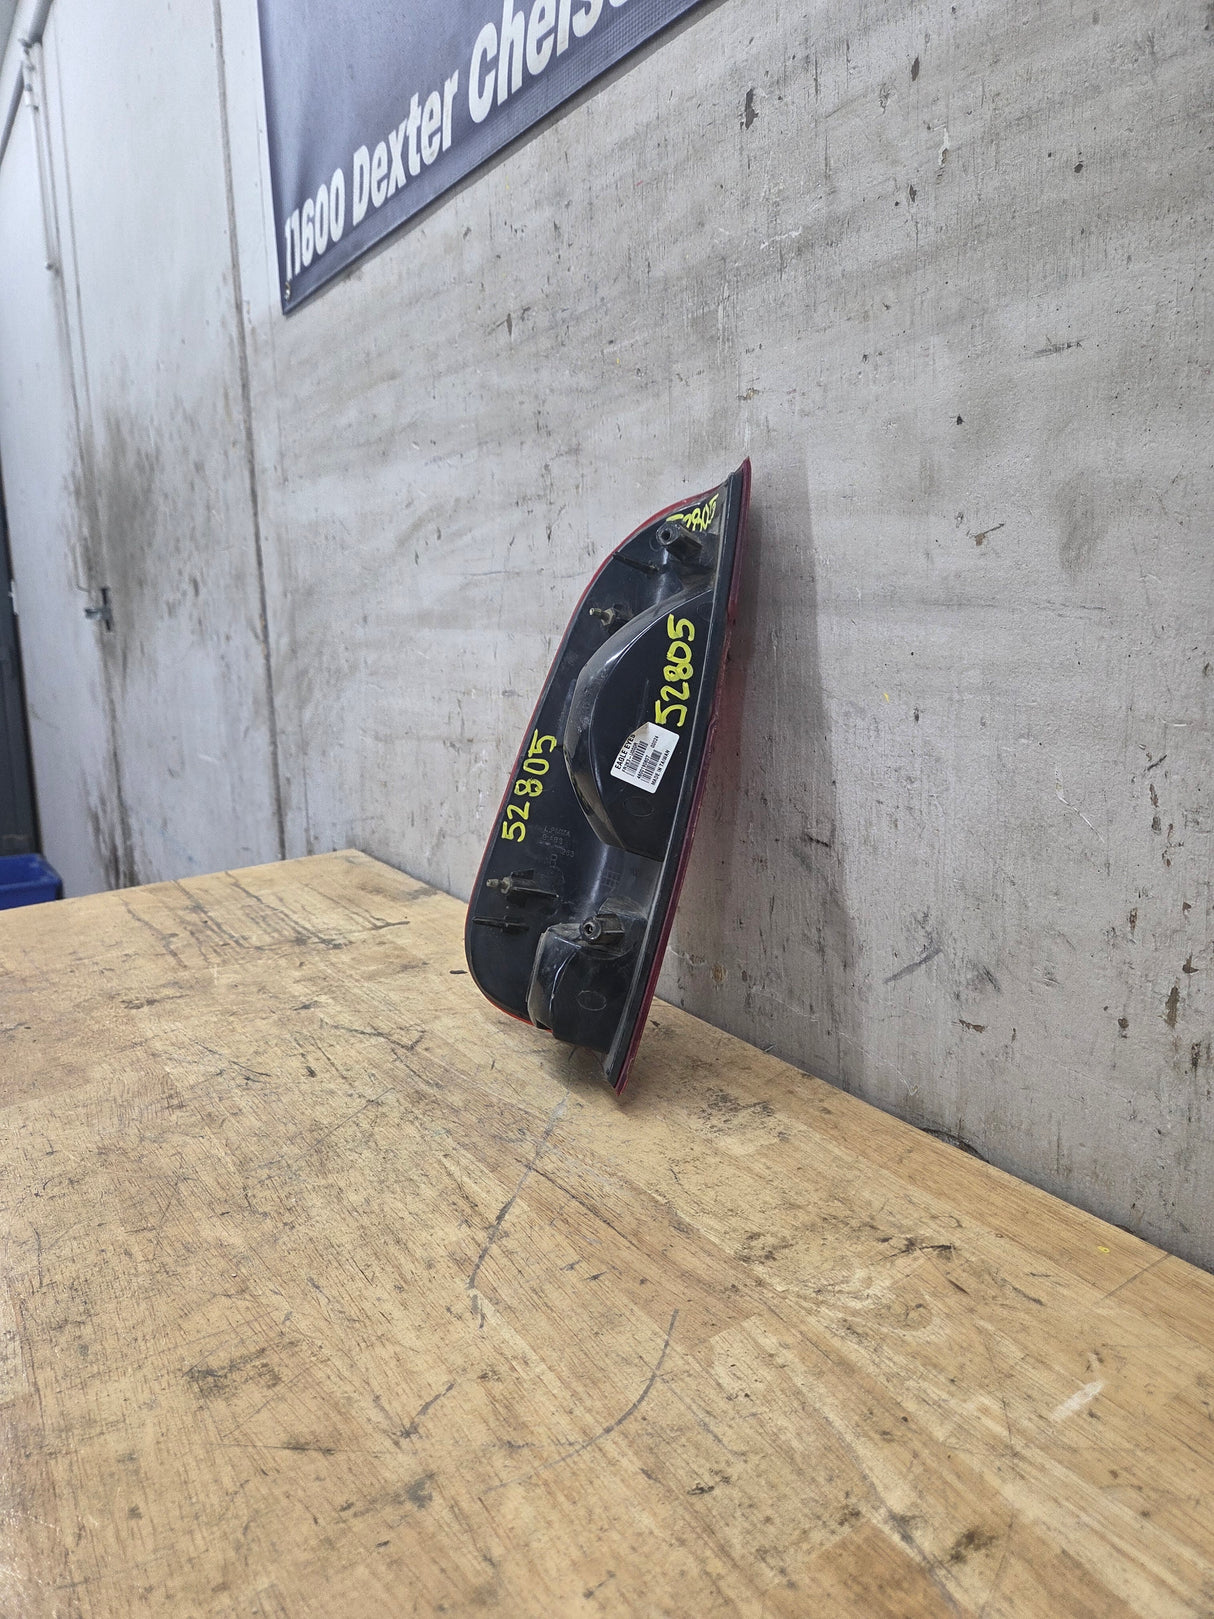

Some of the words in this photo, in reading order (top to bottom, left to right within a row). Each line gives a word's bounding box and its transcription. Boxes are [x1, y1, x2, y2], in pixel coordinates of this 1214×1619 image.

[285, 168, 345, 279] 11600
[353, 69, 459, 226] Dexter
[655, 613, 695, 727] 52805
[501, 728, 557, 842] 52805
[615, 750, 627, 770] EAGLE
[624, 734, 636, 749] EYES
